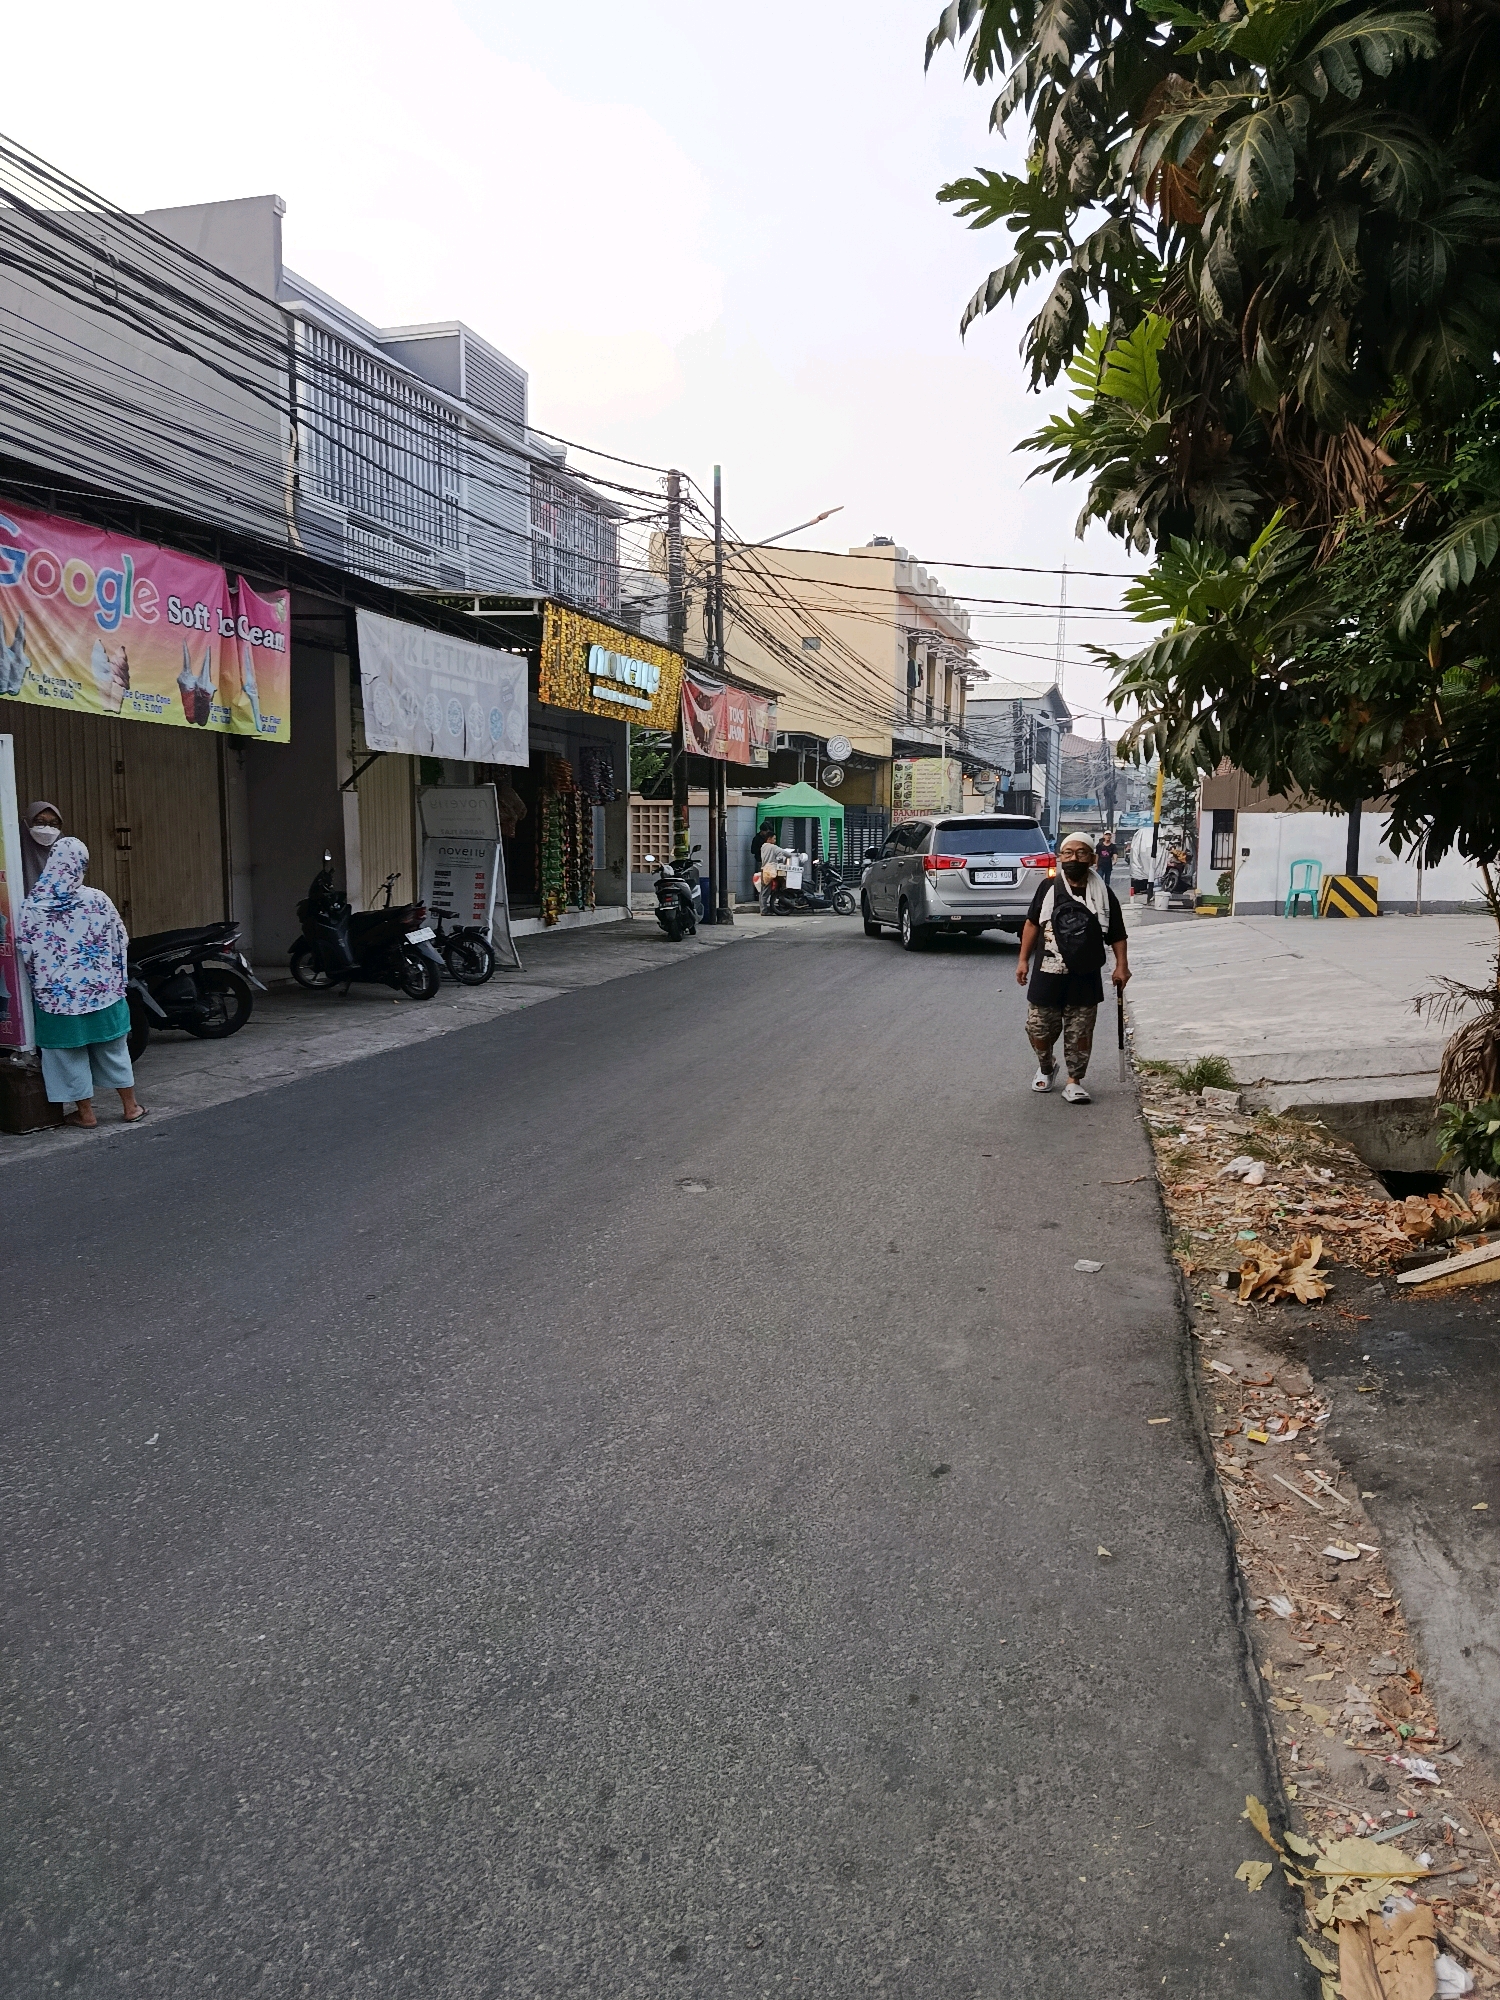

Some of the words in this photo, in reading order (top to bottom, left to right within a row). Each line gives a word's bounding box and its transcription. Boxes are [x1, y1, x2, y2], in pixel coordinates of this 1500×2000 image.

[0, 514, 160, 632] Google
[168, 595, 210, 632] Soft
[438, 847, 486, 858] novelly
